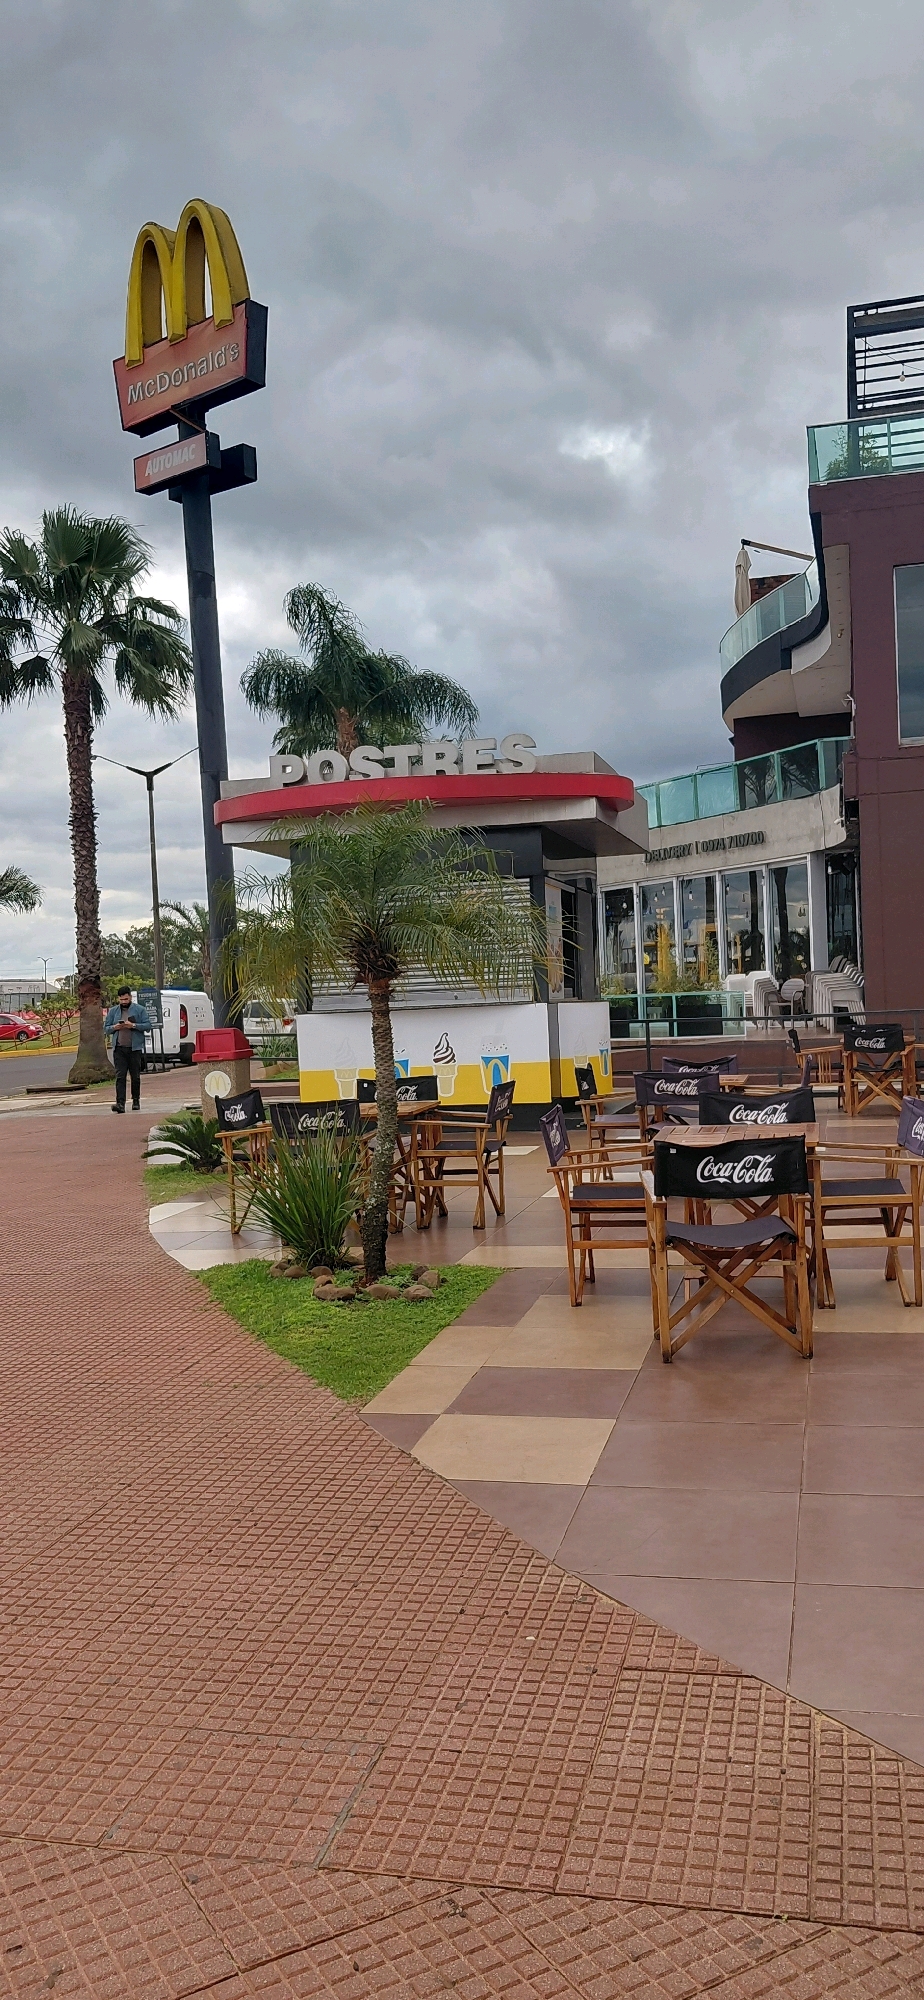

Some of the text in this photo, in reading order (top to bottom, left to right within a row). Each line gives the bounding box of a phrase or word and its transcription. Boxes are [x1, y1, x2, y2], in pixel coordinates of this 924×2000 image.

[127, 342, 240, 406] McDonald's
[145, 443, 196, 477] AUTOMAC
[269, 733, 536, 788] POSTRES
[644, 842, 693, 863] DELIVERY
[726, 831, 767, 849] 710700
[855, 1037, 886, 1049] Coca-Cola
[653, 1078, 699, 1096] Coca-Cola
[729, 1101, 789, 1124] Coca-Cola
[696, 1154, 775, 1184] Coca-Cola
